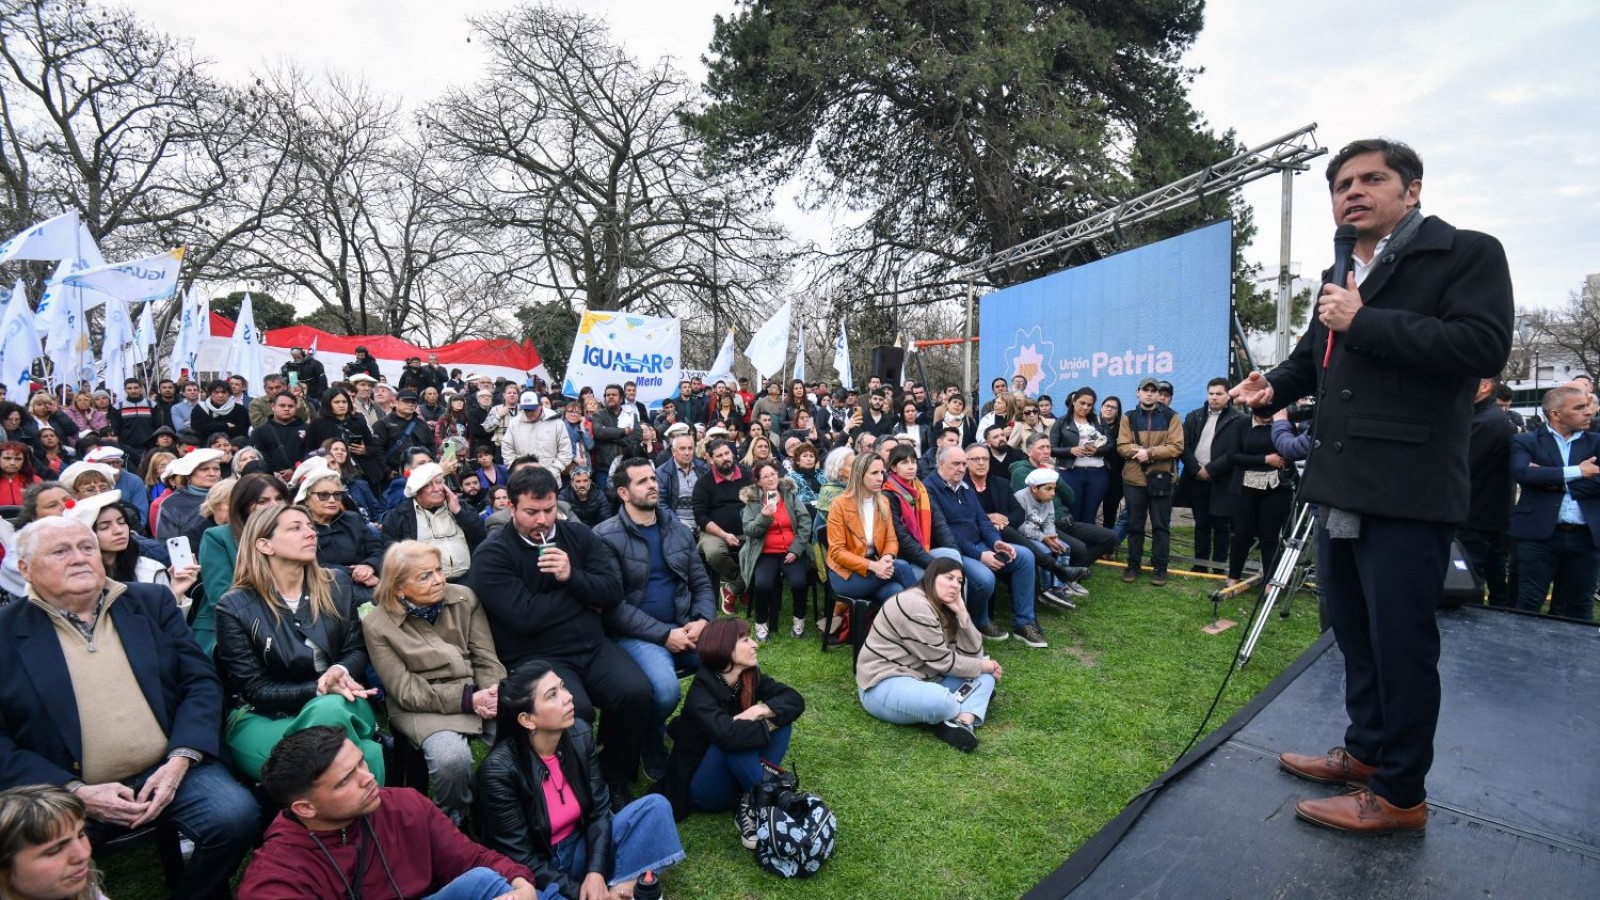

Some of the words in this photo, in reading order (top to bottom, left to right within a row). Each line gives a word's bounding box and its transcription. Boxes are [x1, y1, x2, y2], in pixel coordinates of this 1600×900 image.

[582, 344, 662, 373] IGUALAR
[1059, 357, 1089, 370] Unión
[1092, 345, 1173, 377] Patria
[636, 376, 663, 387] Merlo
[1060, 373, 1071, 381] por
